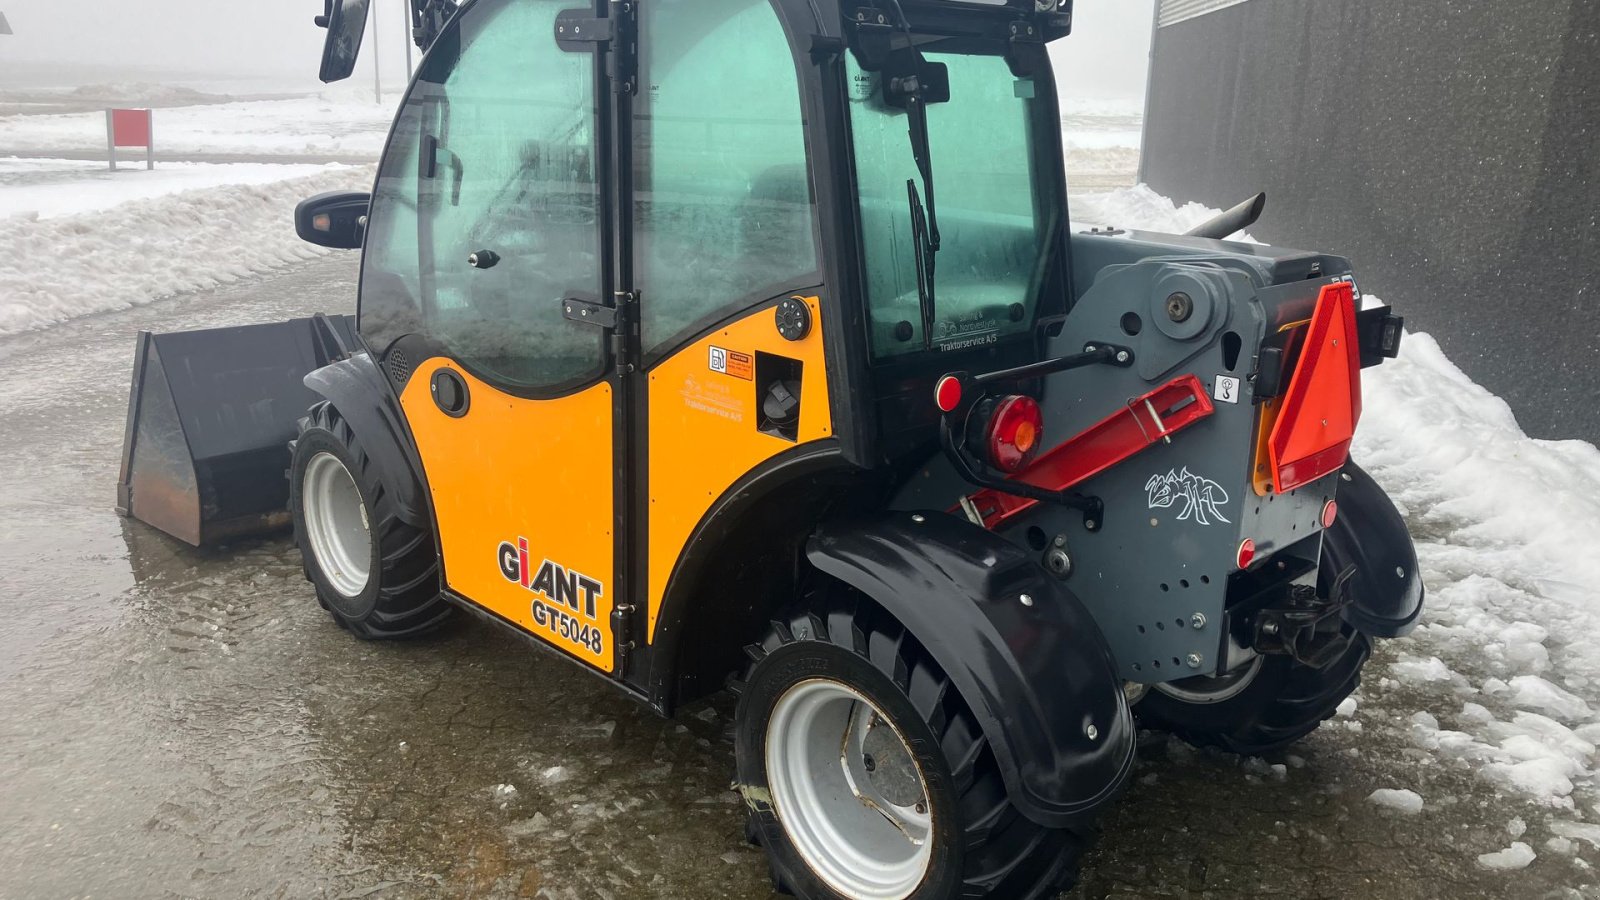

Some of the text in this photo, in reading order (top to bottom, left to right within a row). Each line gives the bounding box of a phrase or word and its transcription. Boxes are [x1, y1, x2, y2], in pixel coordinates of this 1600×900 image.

[940, 333, 997, 352] Traktorservice A/S
[531, 598, 603, 656] GT5048
